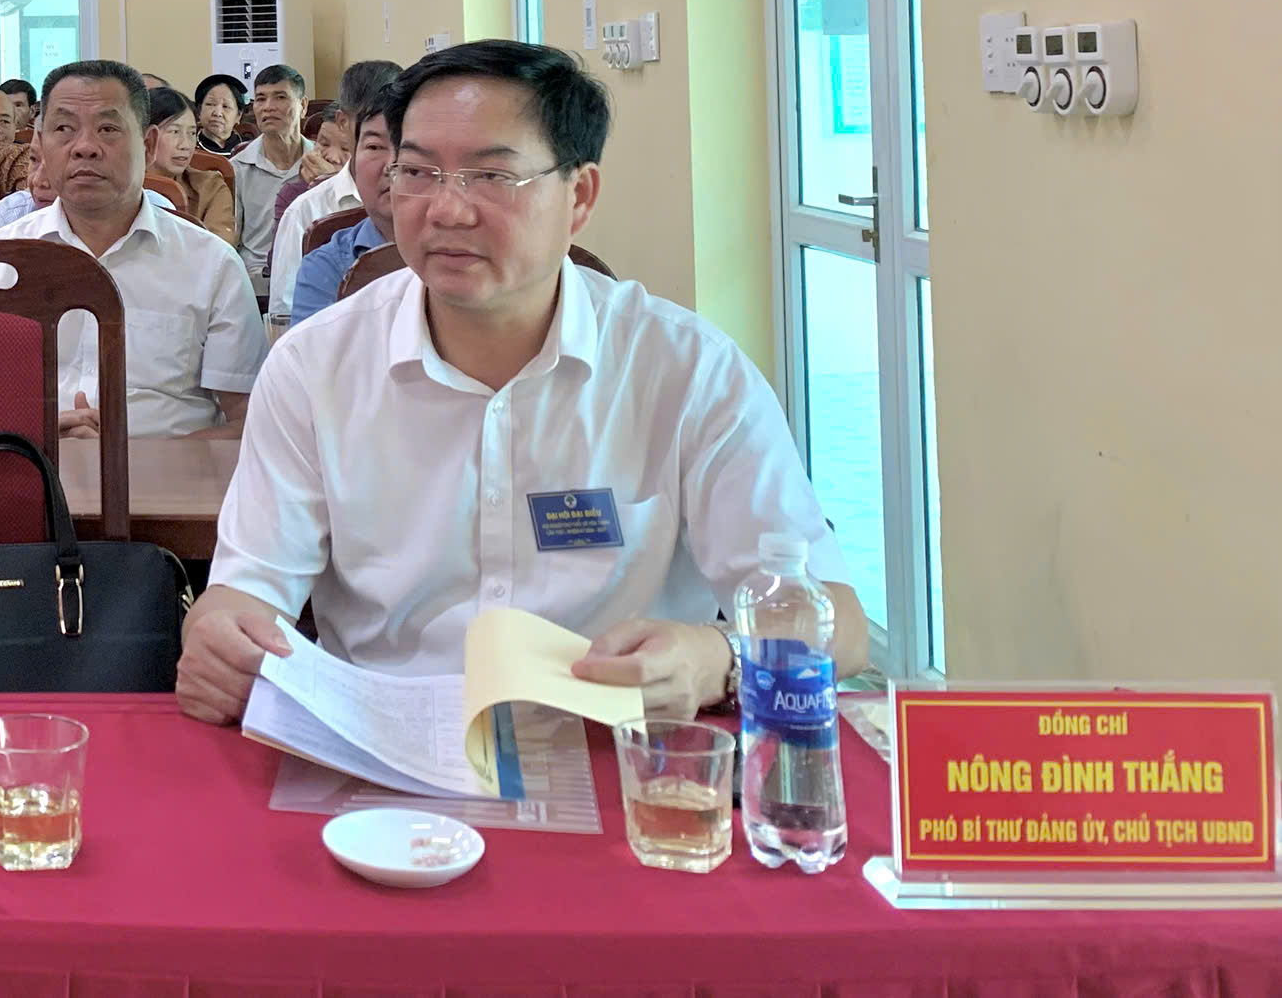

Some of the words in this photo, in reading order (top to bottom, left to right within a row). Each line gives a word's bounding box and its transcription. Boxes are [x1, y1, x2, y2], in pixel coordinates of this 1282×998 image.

[1096, 712, 1128, 736] CHÍ
[947, 753, 1033, 793] NÔNG
[1041, 753, 1115, 794] ĐÌNH
[919, 814, 956, 842] PHÓ
[962, 814, 982, 842] BÍ
[985, 817, 1023, 842] THƯ
[1112, 812, 1151, 843] CHỦ
[1155, 819, 1198, 848] TỊCH
[1202, 820, 1255, 844] UBND
